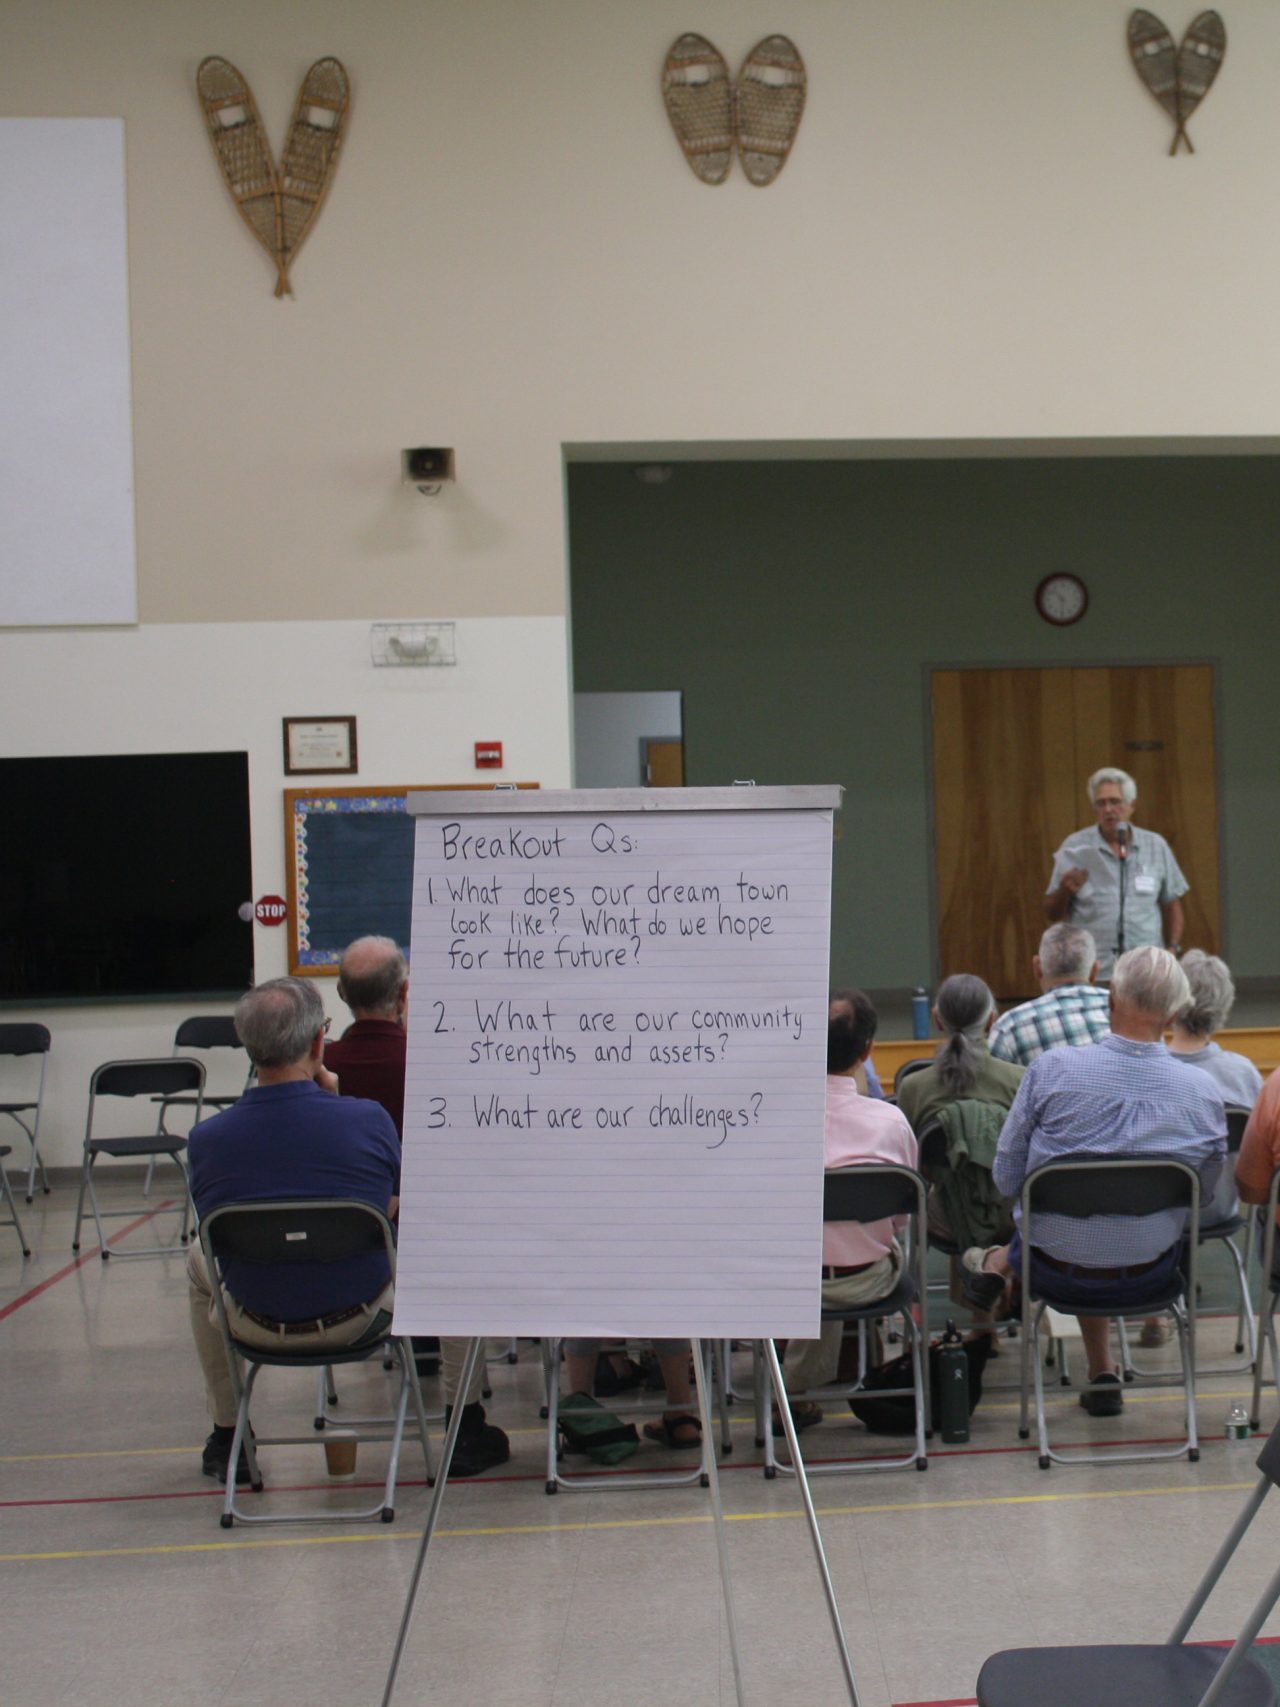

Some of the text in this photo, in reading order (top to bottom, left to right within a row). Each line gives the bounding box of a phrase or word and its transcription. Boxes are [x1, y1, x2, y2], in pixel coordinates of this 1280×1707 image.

[442, 822, 639, 860] Breakout Qs:
[446, 875, 503, 905] What
[524, 873, 575, 905] does
[592, 884, 635, 905] our
[647, 870, 720, 905] dream
[736, 871, 789, 903] town
[256, 903, 286, 918] STOP
[451, 903, 775, 941] look like? What do we hope
[448, 934, 641, 970] for the future?
[433, 999, 803, 1040] 2. What are our community
[469, 1032, 729, 1075] strengths and assets?
[427, 1092, 763, 1149] 3. What are our challenges?
